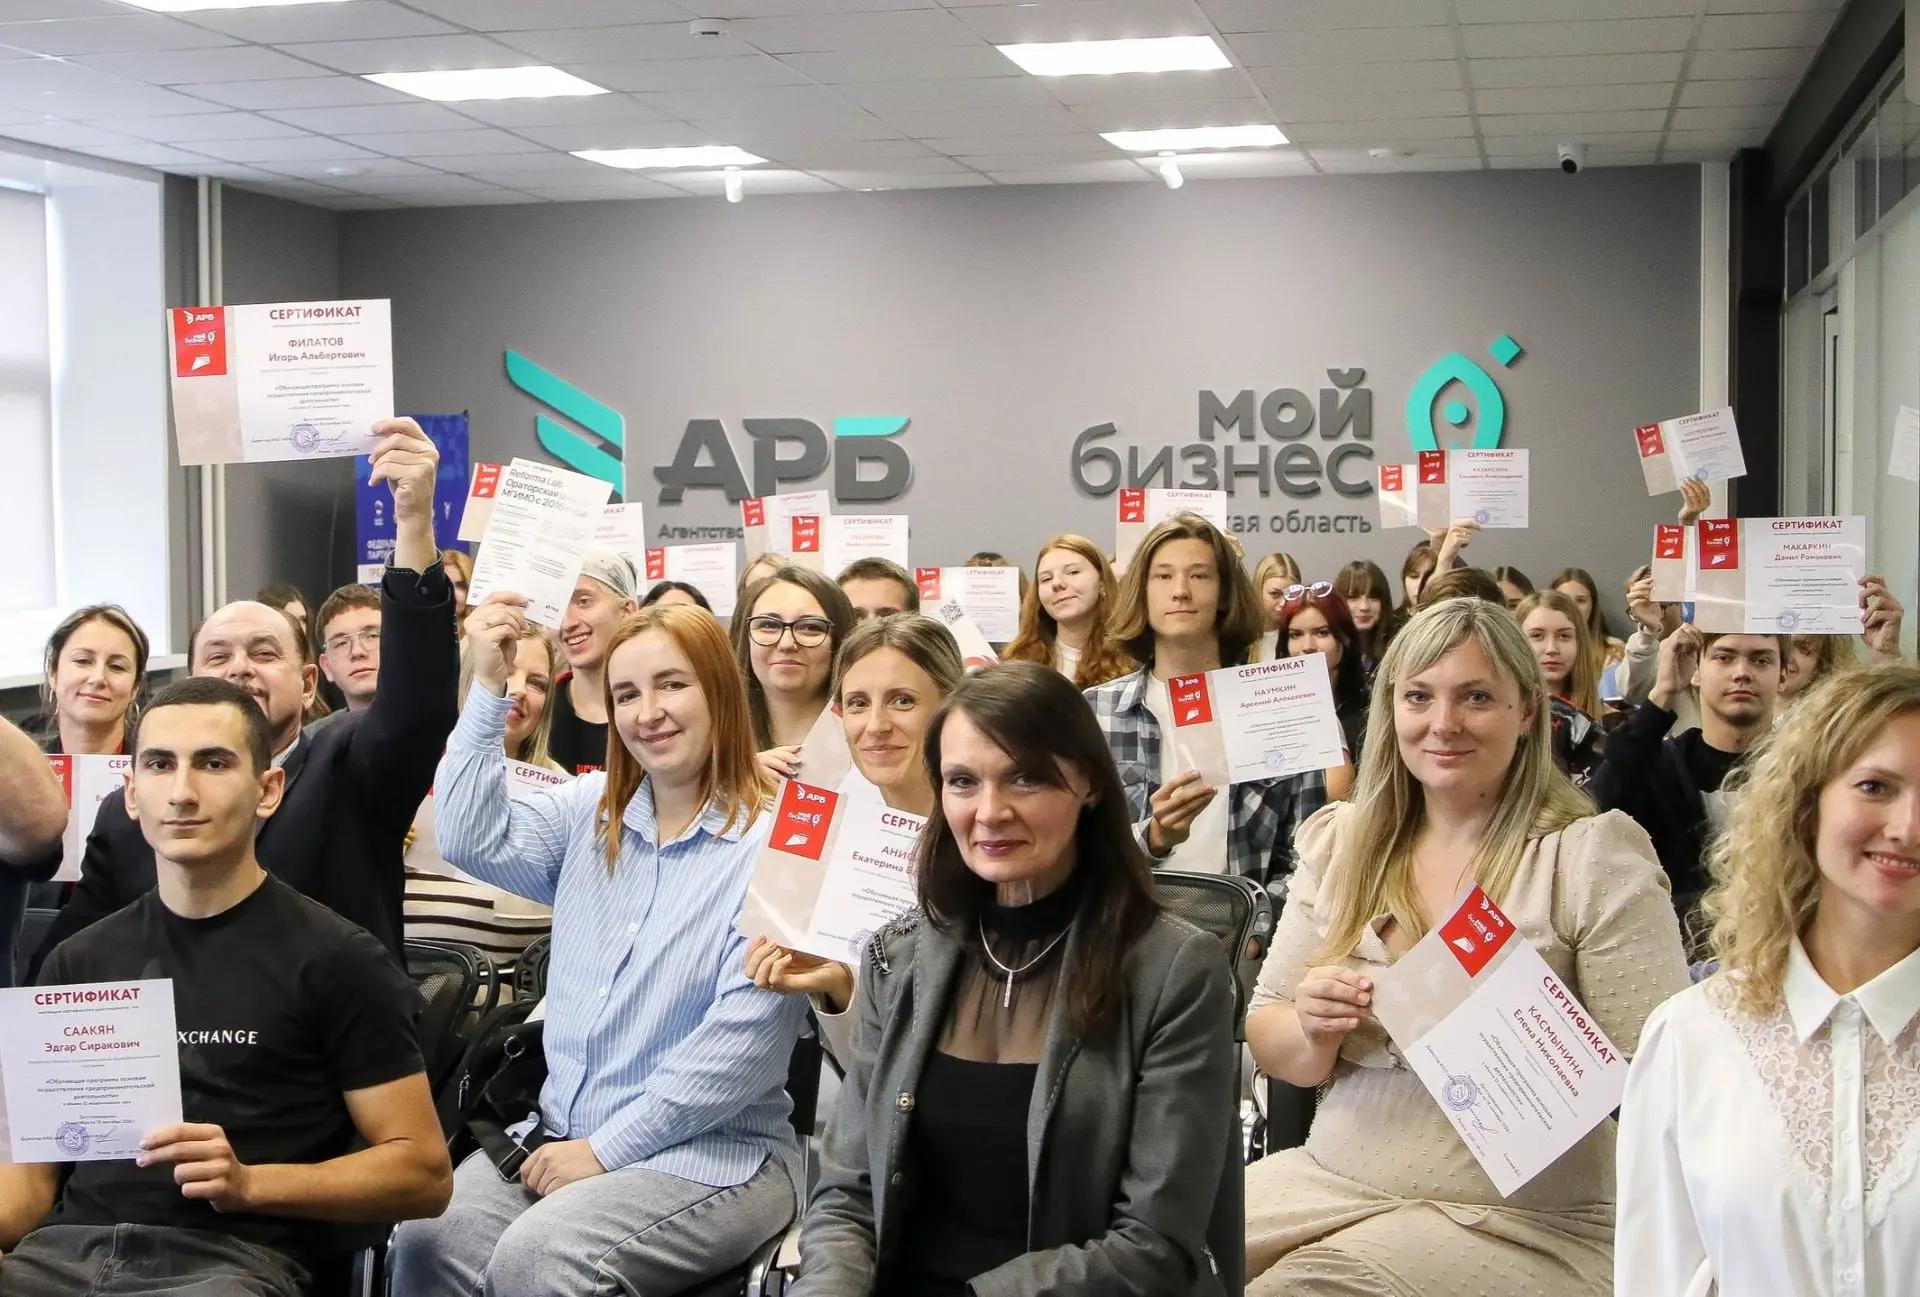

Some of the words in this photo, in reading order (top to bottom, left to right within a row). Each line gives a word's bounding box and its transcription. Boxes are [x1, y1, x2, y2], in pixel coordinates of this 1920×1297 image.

[195, 313, 214, 321] АРБ
[269, 306, 362, 320] СЕРТИФИКАТ
[288, 337, 344, 348] ФИЛАТОВ
[269, 353, 298, 362] Игорь
[300, 351, 366, 360] Альбертович
[1197, 367, 1373, 440] мой
[1678, 411, 1720, 425] СЕРТИФИКАТ
[654, 416, 912, 504] АРБ
[1071, 421, 1374, 497] бизнес
[509, 468, 546, 484] Reforma
[547, 479, 564, 488] Lab
[505, 478, 560, 498] Ораторская
[1269, 508, 1372, 534] область
[1771, 520, 1843, 530] СЕРТИФИКАТ
[658, 523, 744, 539] Агентство
[1783, 543, 1831, 551] МАКАРКИН
[1238, 659, 1306, 678] СЕРТИФИКАТ
[1254, 684, 1296, 697] НАУМКИН
[1240, 698, 1272, 709] Арсений
[1273, 692, 1316, 703] Алексеевич
[514, 766, 568, 786] СЕРТИФИ
[806, 793, 826, 804] АРБ
[881, 813, 923, 833] СЕРТИ
[851, 851, 904, 873] Екатерина
[1488, 909, 1505, 928] АРБ
[34, 987, 141, 1006] СЕРТИФИКАТ
[1540, 974, 1616, 1067] СЕРТИФИКАТ
[63, 1024, 115, 1037] СААКЯН
[176, 1030, 259, 1045] XCHANGE
[44, 1042, 77, 1053] Эдгар
[79, 1040, 140, 1052] Сиракович
[1526, 1004, 1586, 1079] КАСМЫНИНА
[1511, 1008, 1538, 1040] Елена
[1533, 1037, 1581, 1097] Николаевна
